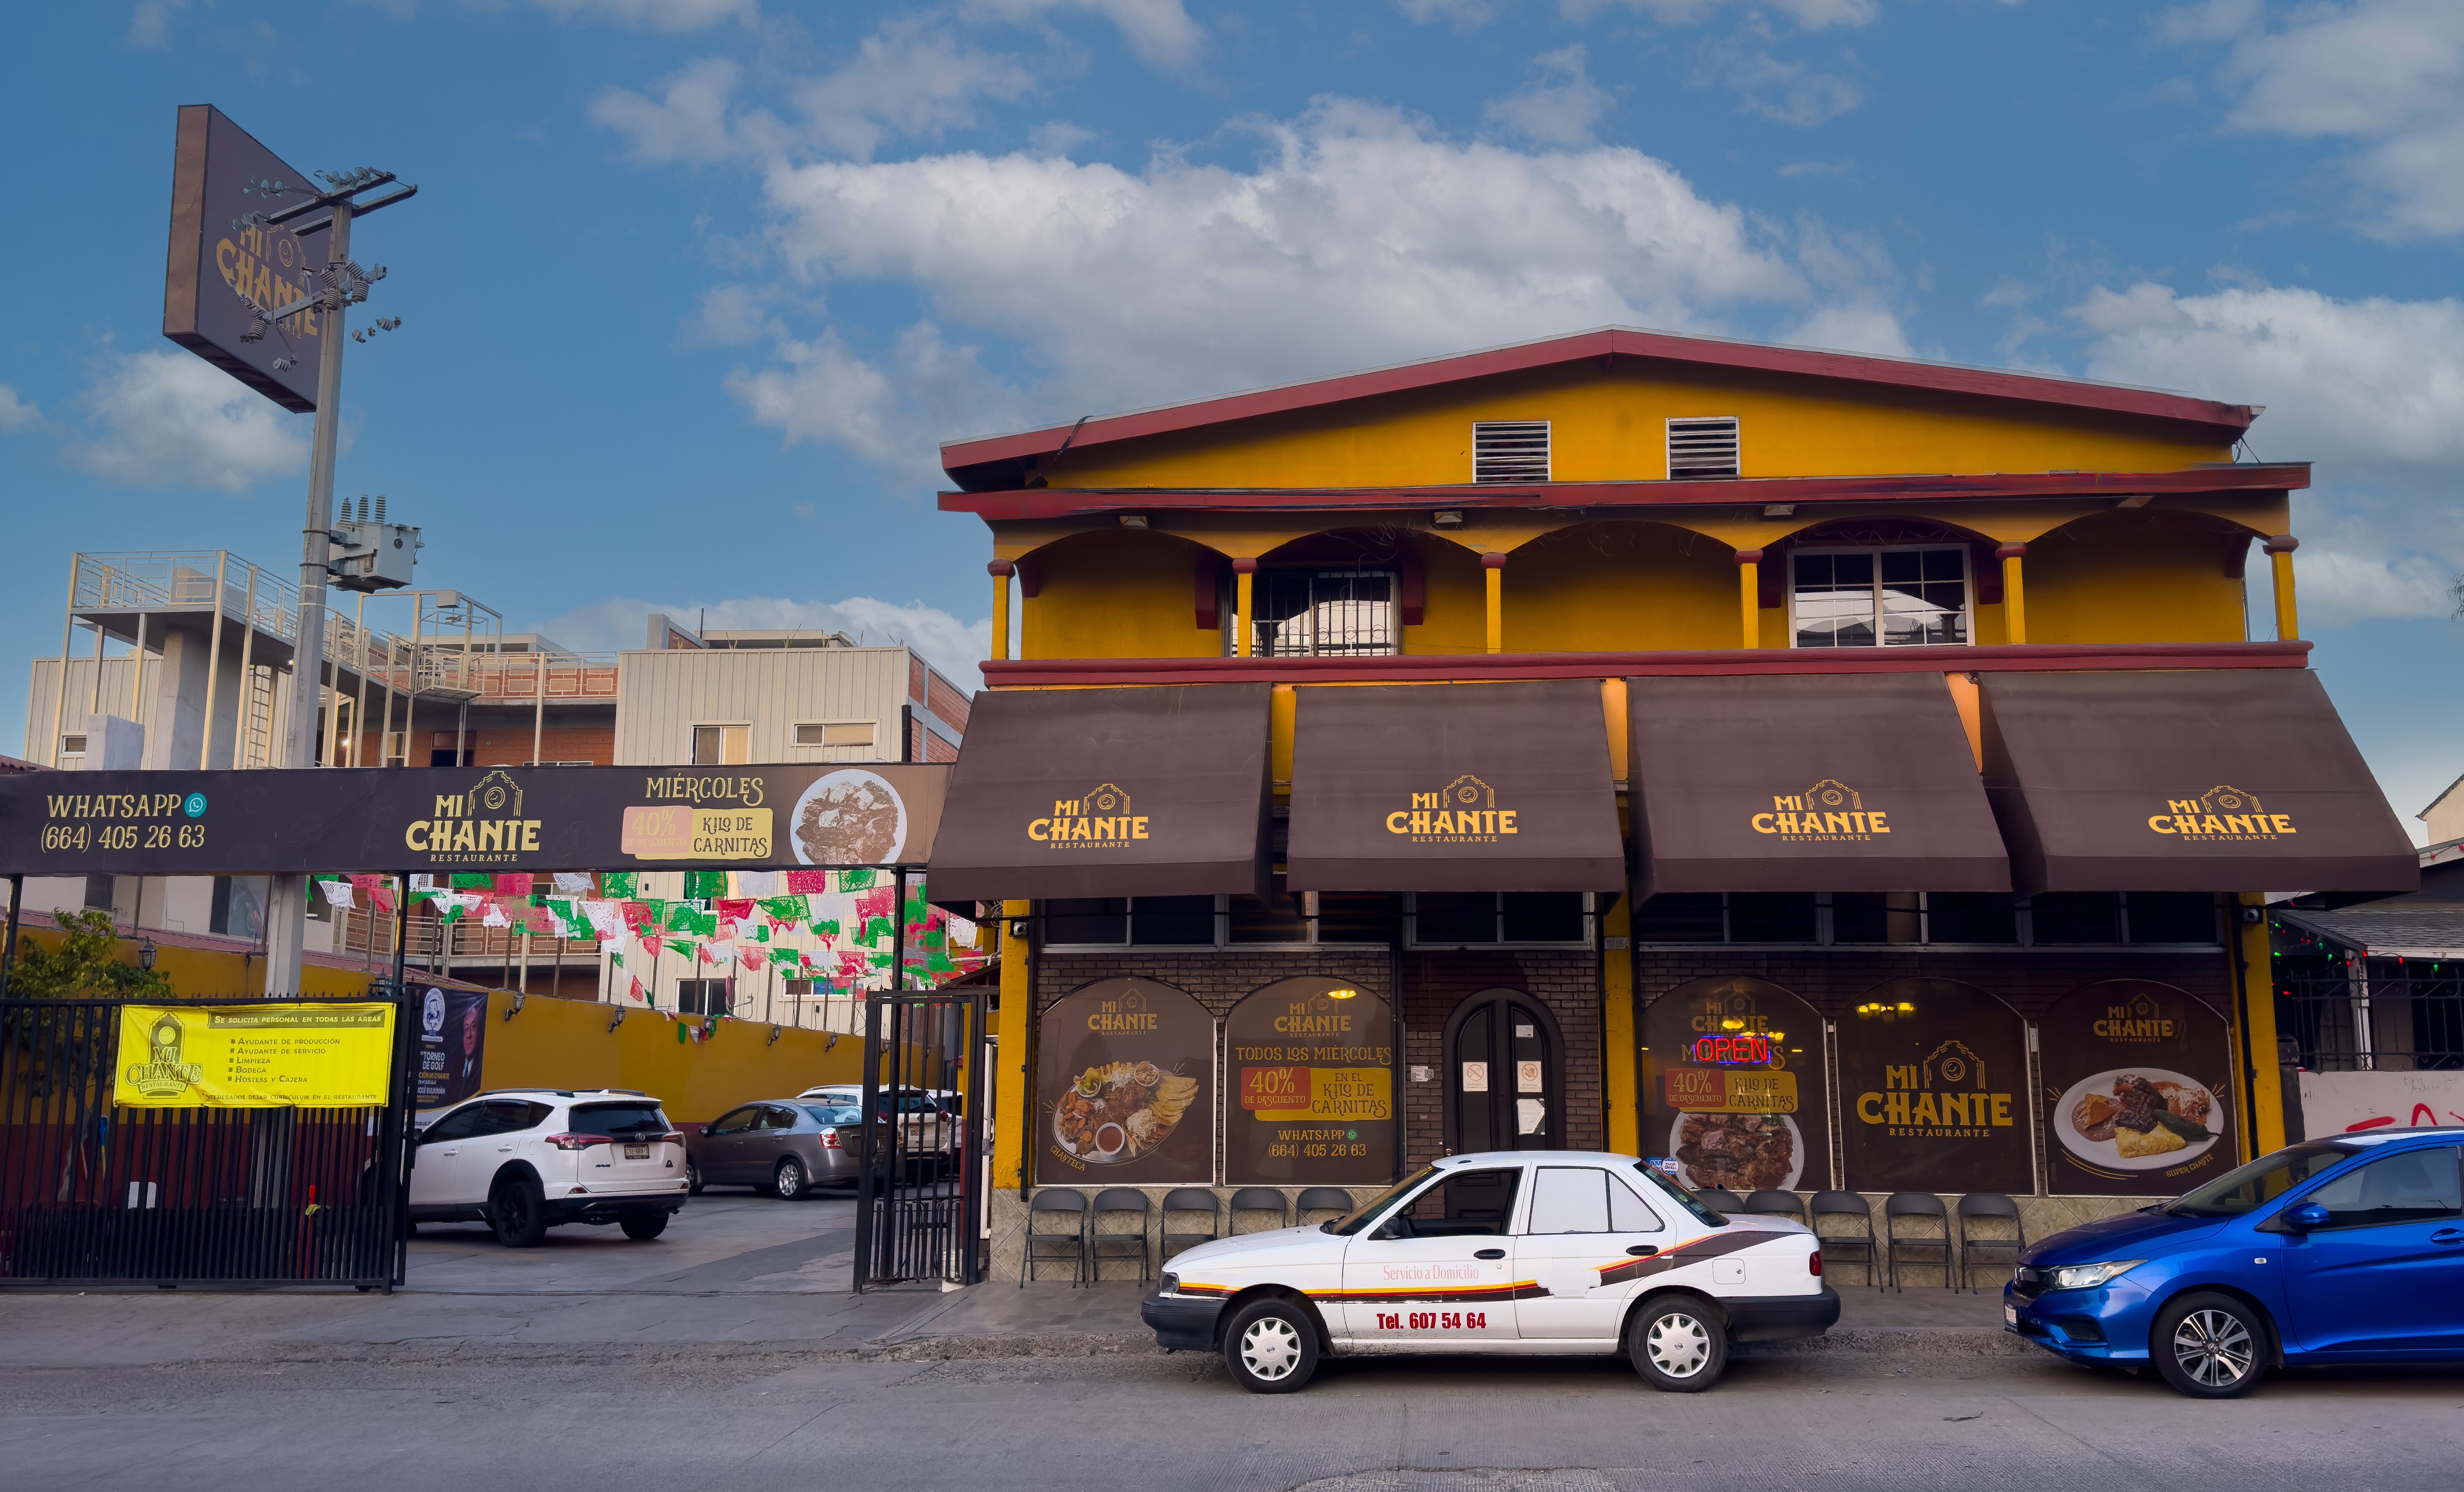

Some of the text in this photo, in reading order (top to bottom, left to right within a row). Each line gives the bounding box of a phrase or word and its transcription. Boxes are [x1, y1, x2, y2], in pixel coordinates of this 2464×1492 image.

[240, 227, 262, 258] MI
[645, 773, 763, 806] MIÉRCOLES
[47, 794, 181, 818] WHATSAPP
[434, 795, 464, 817] MI
[1054, 800, 1079, 816] MI
[1412, 793, 1438, 808] MI
[1774, 796, 1803, 810] MI
[2167, 800, 2201, 813] MI
[631, 807, 676, 837] 40%
[702, 817, 753, 835] KILO DE
[1028, 816, 1148, 841] CHANTE
[1387, 810, 1517, 834] CHANTE
[1751, 812, 1890, 834] CHANTE
[2148, 815, 2297, 834] CHANTE
[41, 822, 205, 854] (664) 405 26 63
[406, 820, 541, 851] CHANTE
[638, 838, 686, 850] DESCUENTO
[694, 838, 767, 857] CARNITAS
[1102, 1001, 1116, 1013] MI
[1289, 1003, 1305, 1015] MI
[1706, 1002, 1722, 1014] MI
[2108, 1006, 2124, 1018] MI
[1088, 1013, 1157, 1030] CHANTE
[1274, 1015, 1351, 1032] CHANTE
[2093, 1020, 2173, 1036] CHANTE
[152, 1047, 178, 1063] MI
[1235, 1045, 1391, 1065] TODOS LOS MIÉRCOLES
[1696, 1038, 1767, 1061] OPEN
[125, 1063, 203, 1086] CHANTE
[423, 1061, 444, 1071] DE GOLF
[1249, 1068, 1295, 1094] 40%
[1335, 1073, 1362, 1082] EN EL
[1673, 1070, 1711, 1093] 40%
[1735, 1078, 1779, 1093] KILO DE
[1885, 1065, 1918, 1089] MI
[1323, 1083, 1374, 1099] KILO DE
[1680, 1095, 1721, 1104] DESCUENTO
[1257, 1096, 1306, 1106] DESCUENTO
[1312, 1100, 1387, 1118] CARNITAS
[1729, 1095, 1794, 1112] CARNITAS
[1857, 1092, 2013, 1126] CHANTE
[1278, 1130, 1344, 1140] WHATSAPP
[1889, 1128, 1989, 1137] RESTAURANTE
[1050, 1146, 1085, 1171] CHANTECA
[1268, 1142, 1366, 1158] (664) 405 26 63
[2166, 1154, 2213, 1177] SUPER CHANTE
[1383, 1264, 1479, 1280] Servicio a Domicilio
[1377, 1312, 1486, 1329] Tel. 607 54 64
